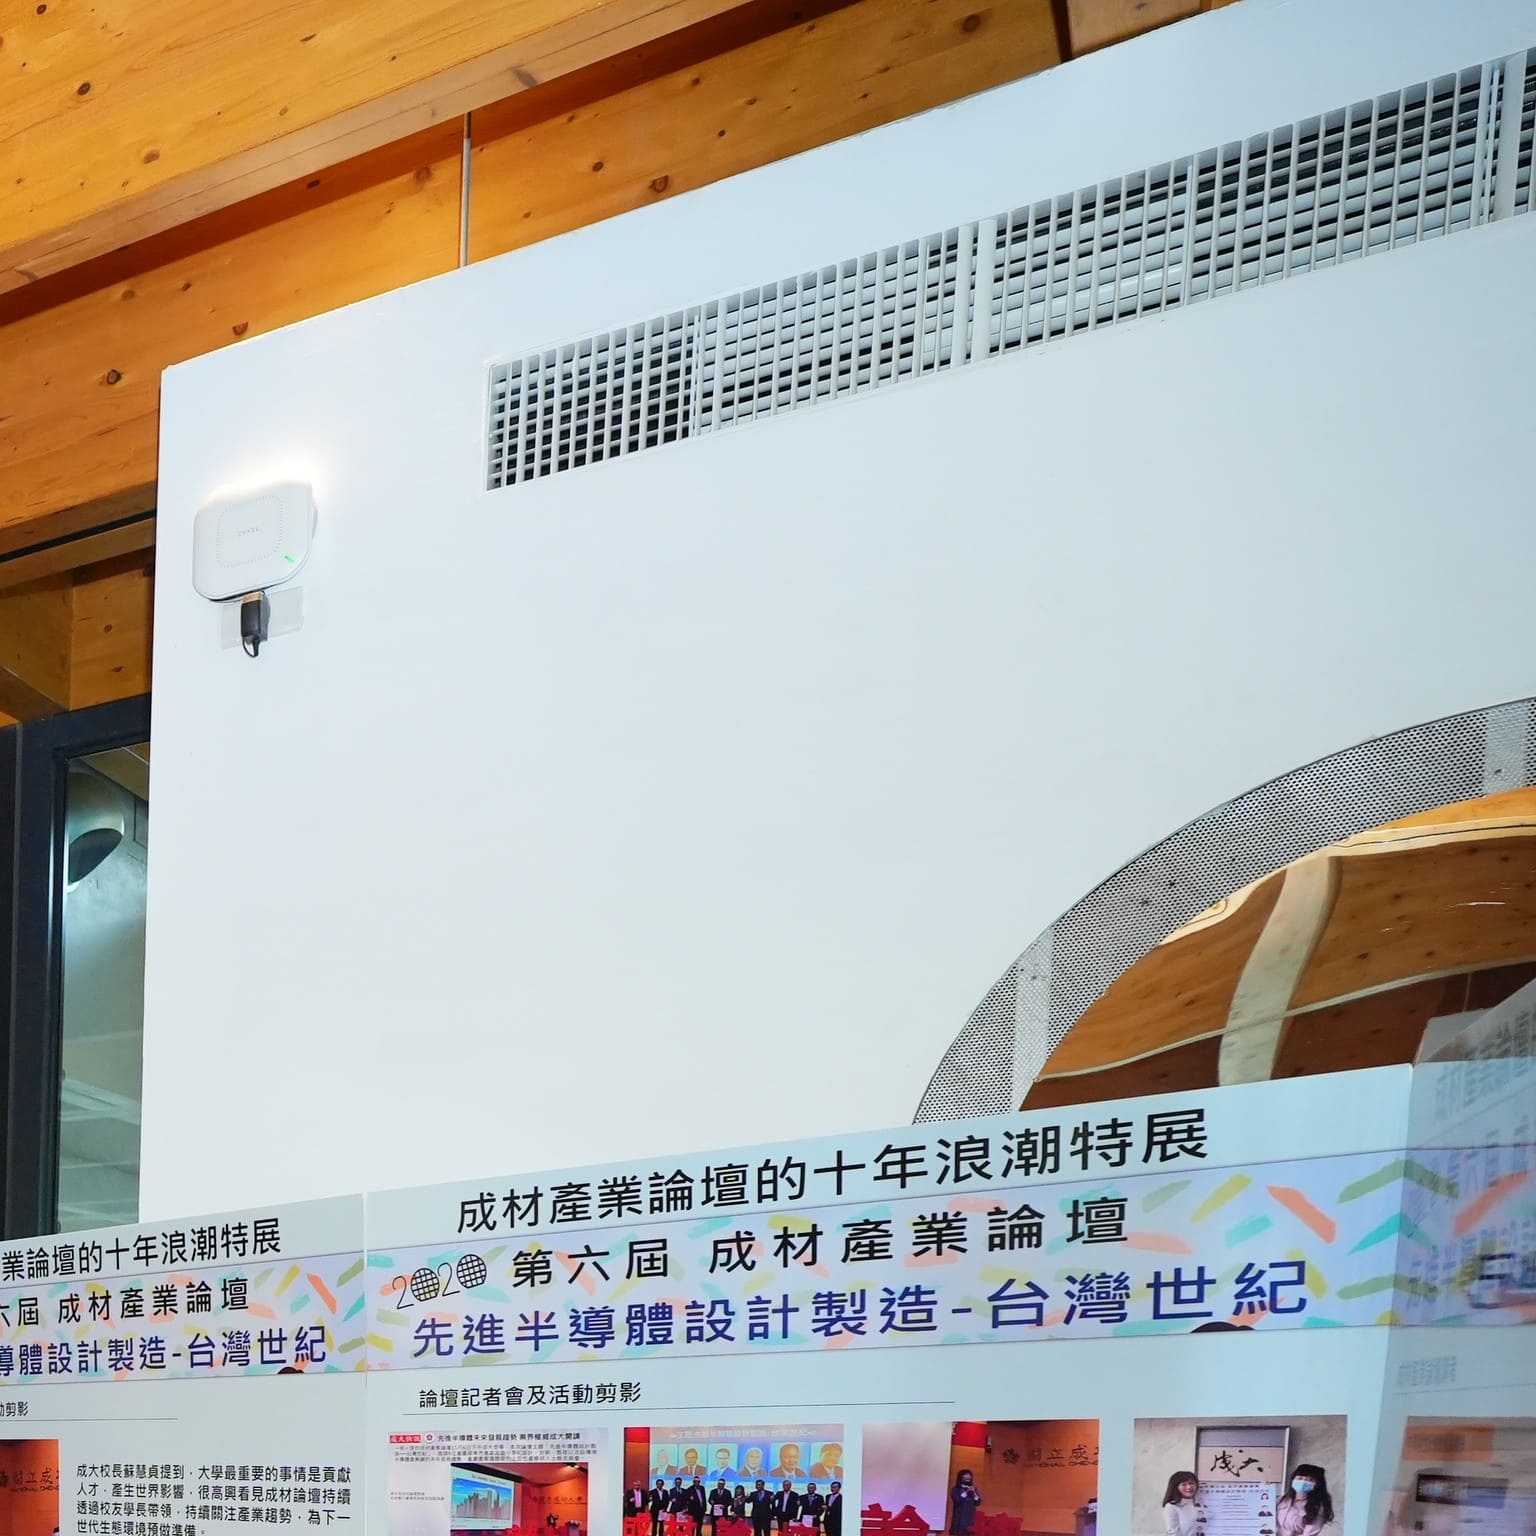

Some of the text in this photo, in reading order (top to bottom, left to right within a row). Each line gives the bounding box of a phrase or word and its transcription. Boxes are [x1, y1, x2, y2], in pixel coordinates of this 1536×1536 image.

[457, 1108, 1209, 1235] 成材產業論壇的十年浪潮特展
[511, 1237, 669, 1289] 第六屆
[708, 1196, 1129, 1274] 成材產業論壇
[57, 1277, 249, 1324] 成材產業論壇
[413, 1260, 1309, 1359] 先進半導體設計製造-台灣世紀
[419, 1381, 641, 1409] 論壇記者會及活動剪影
